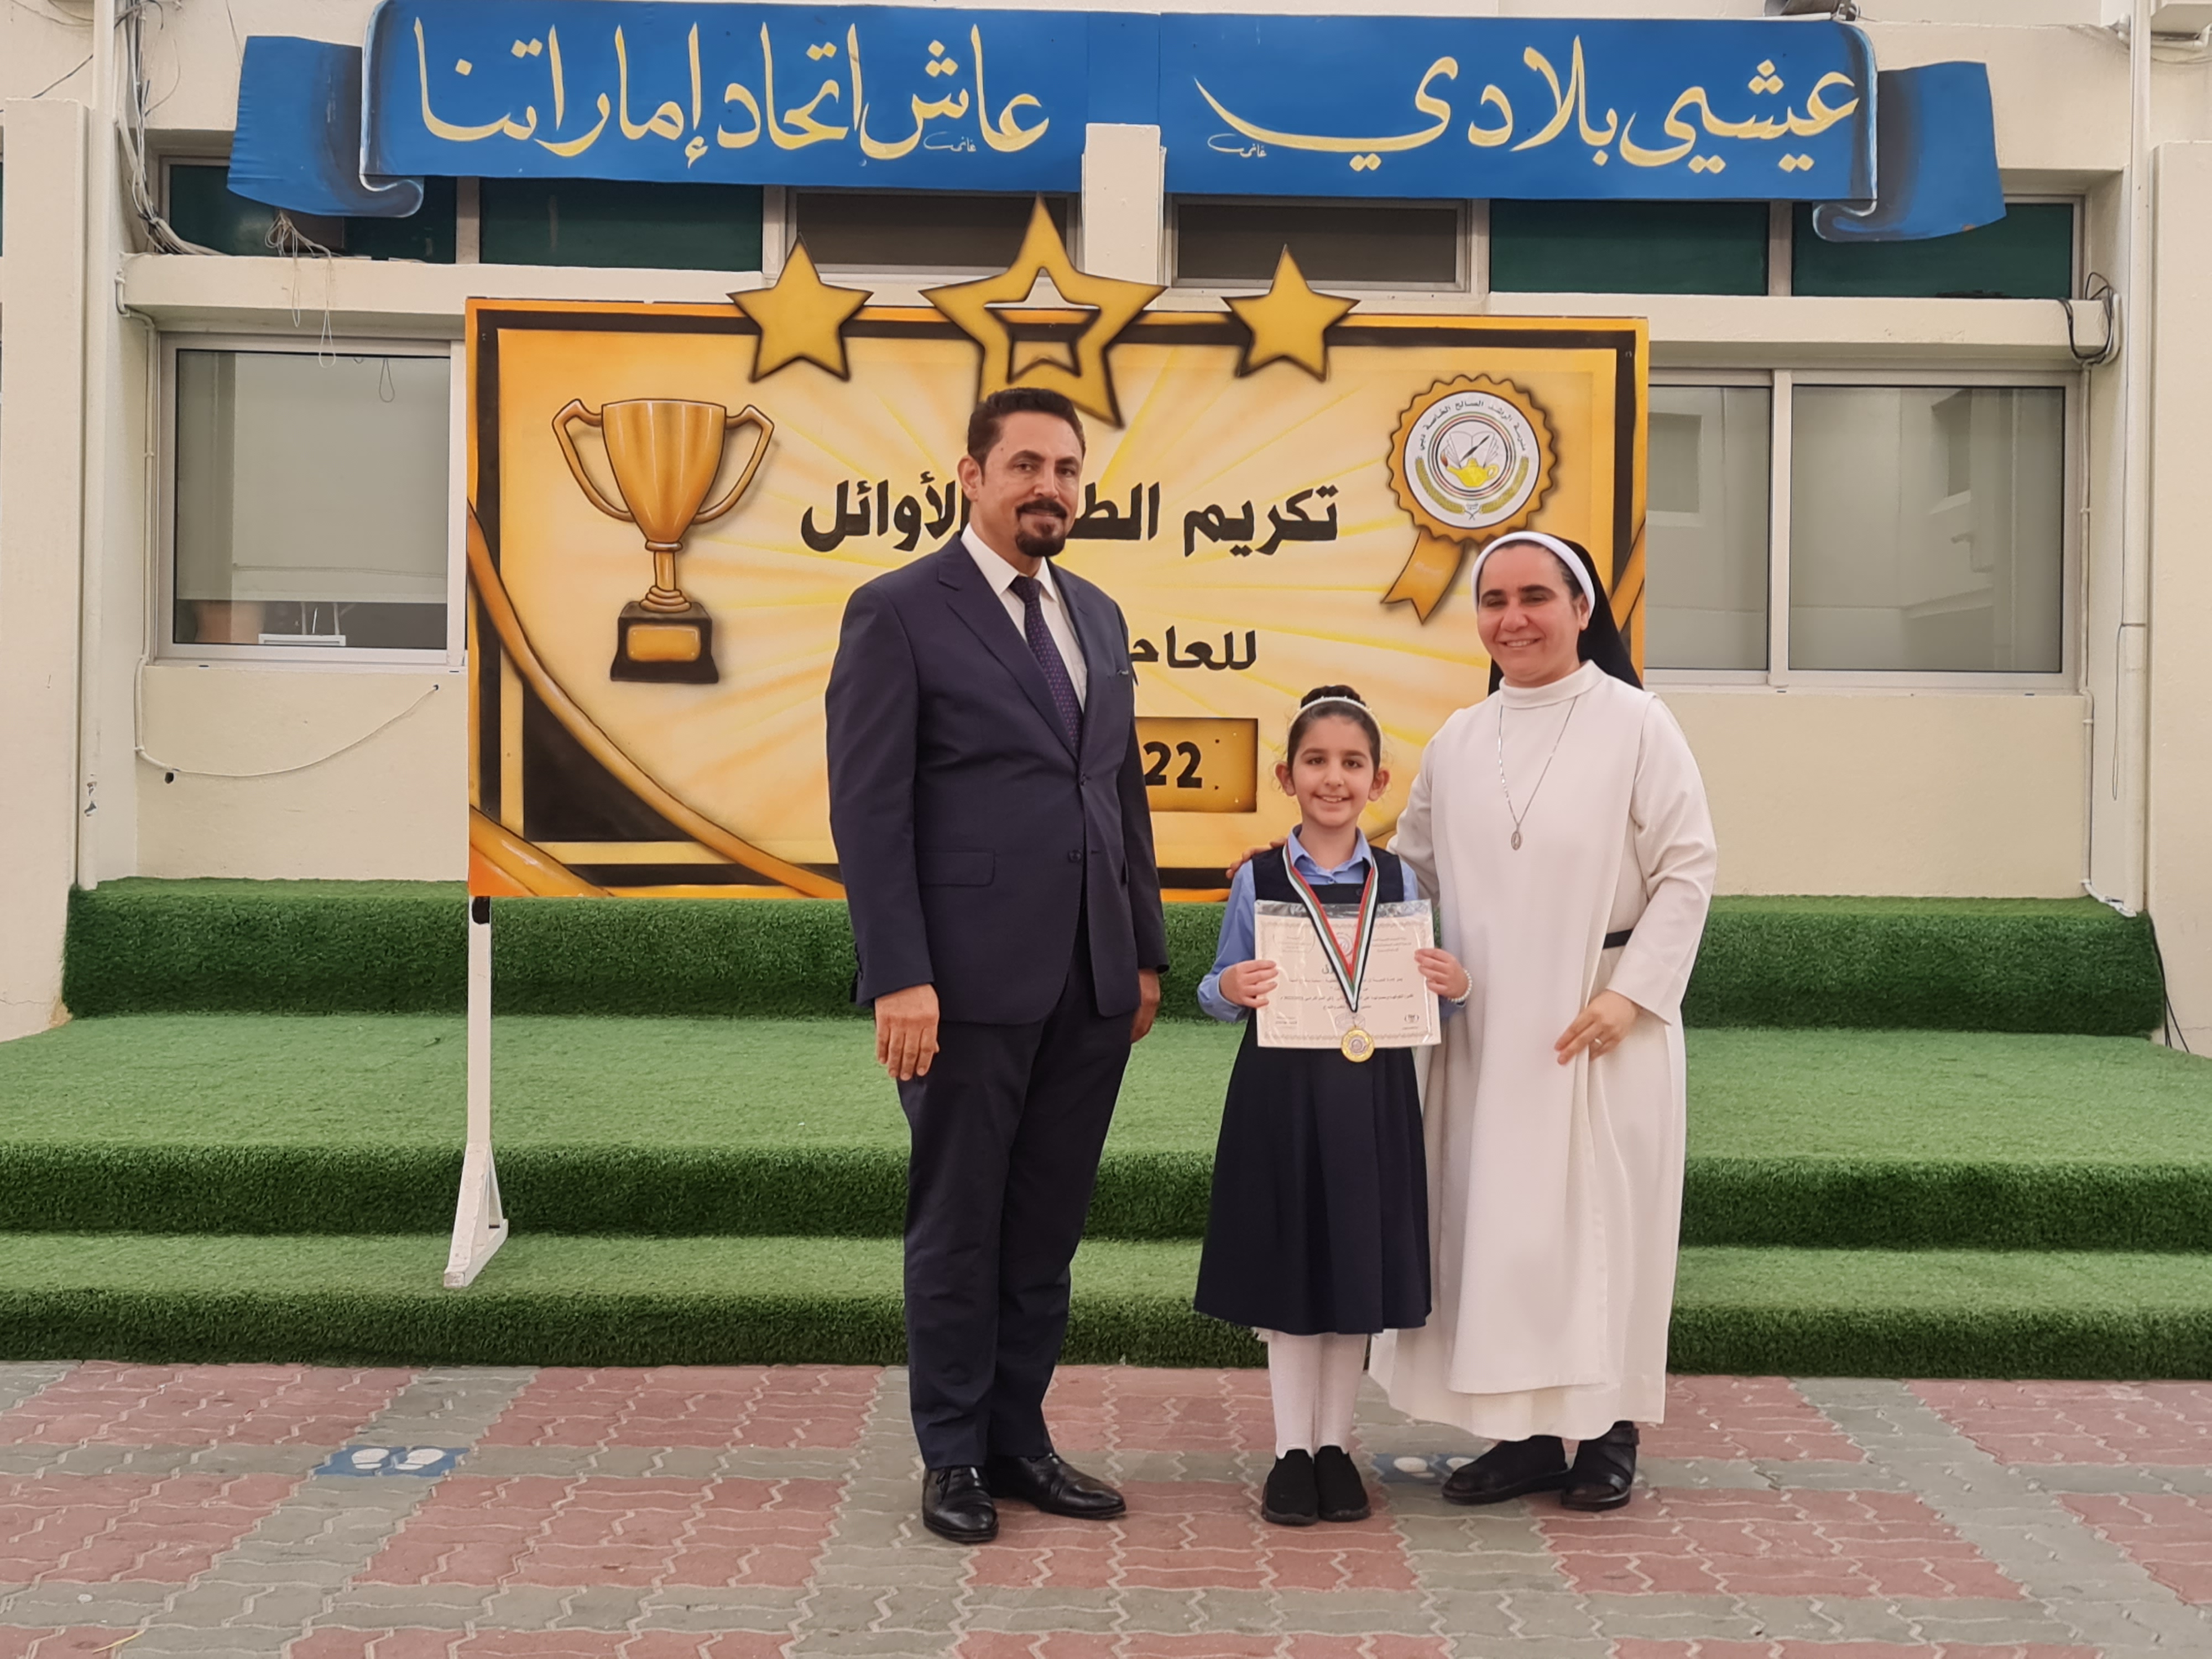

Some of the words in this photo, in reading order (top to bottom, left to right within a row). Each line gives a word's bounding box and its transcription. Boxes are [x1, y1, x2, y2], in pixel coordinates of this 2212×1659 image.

[414, 16, 708, 169] إماراتنا
[717, 22, 863, 150] اتحاد
[860, 23, 1050, 160] عاش
[1193, 34, 1618, 172] بلادي
[1619, 59, 1860, 174] عيشي
[801, 471, 972, 552] الأوائل
[1183, 484, 1339, 557] تكريم
